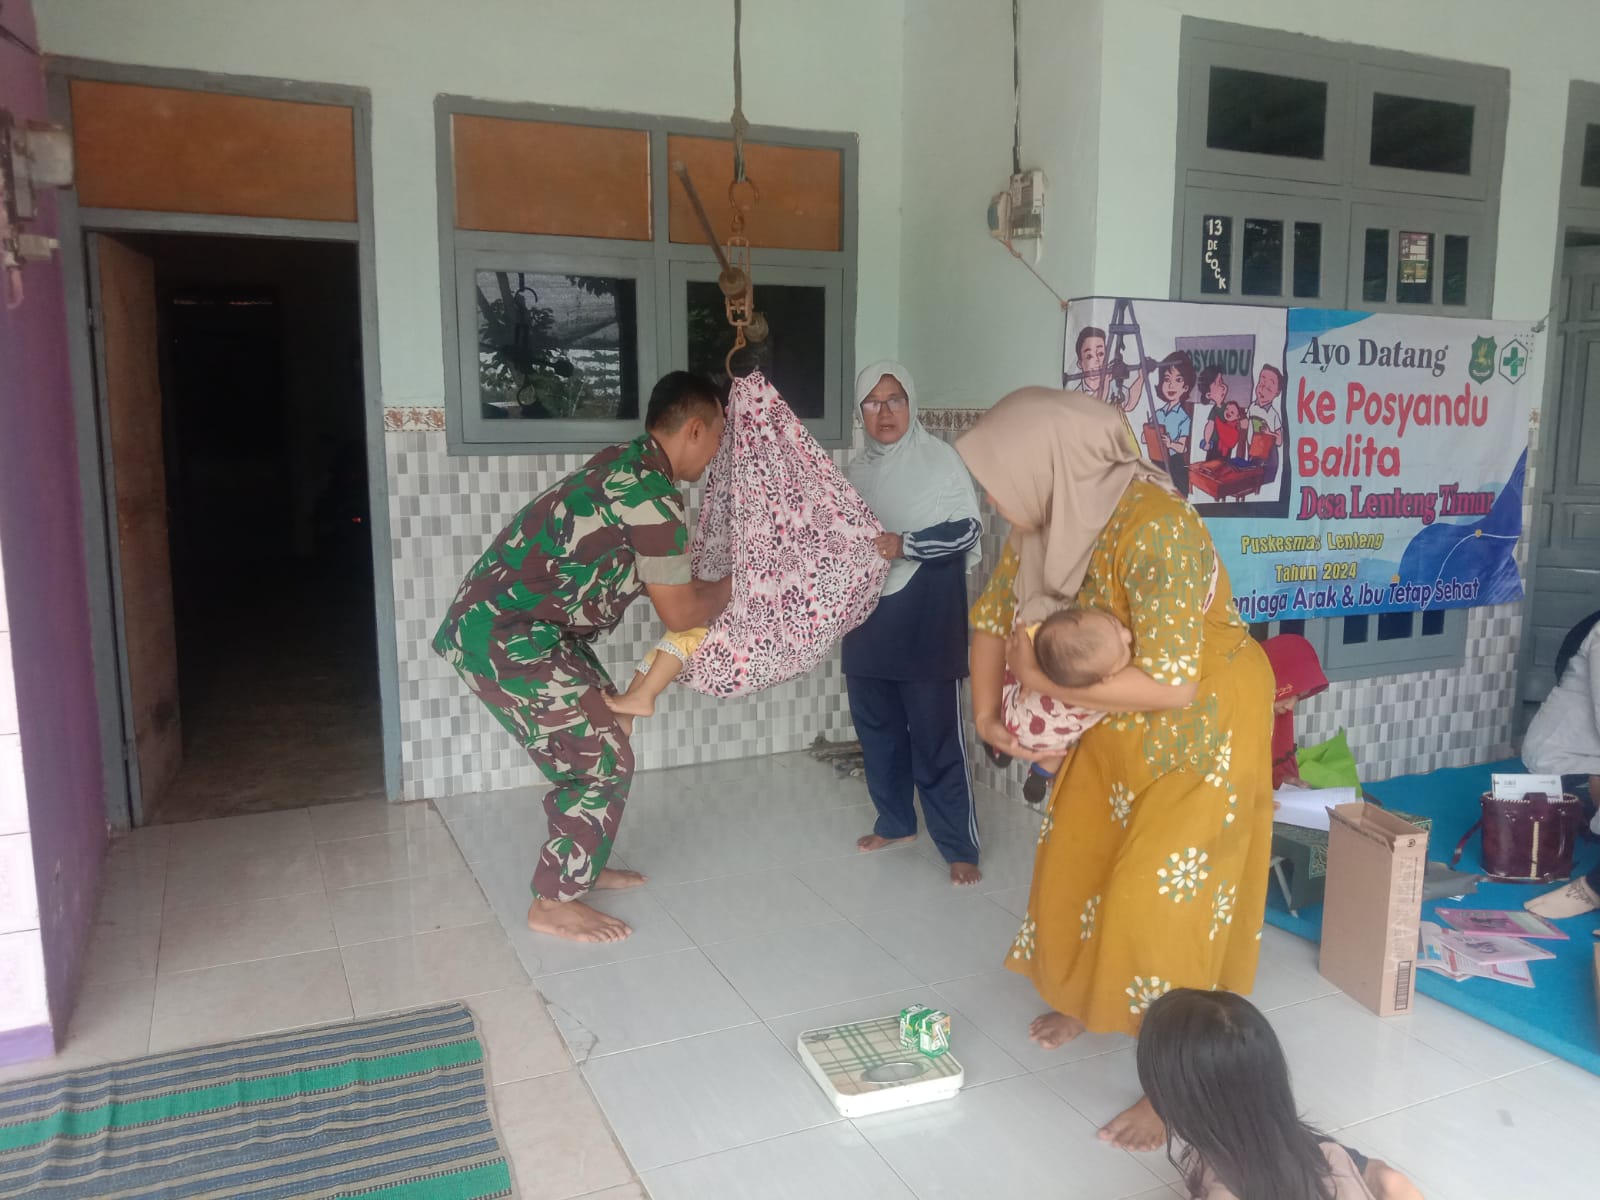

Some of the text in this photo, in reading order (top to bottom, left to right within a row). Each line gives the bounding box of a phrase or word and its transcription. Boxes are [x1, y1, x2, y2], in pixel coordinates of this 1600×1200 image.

[1207, 219, 1222, 235] 13
[1300, 337, 1448, 377] Ayo Datang
[1297, 376, 1489, 438] ke Posyandu
[1297, 434, 1400, 477] Balita
[1297, 482, 1495, 525] Desa Lenteng Timur
[1241, 532, 1384, 554] Puskesmas Lenteng
[1275, 562, 1357, 583] Tahun 2024
[1342, 584, 1354, 607] &
[1359, 582, 1384, 606] Ibu
[1389, 582, 1431, 608] Tetap
[1435, 577, 1479, 601] Sehat
